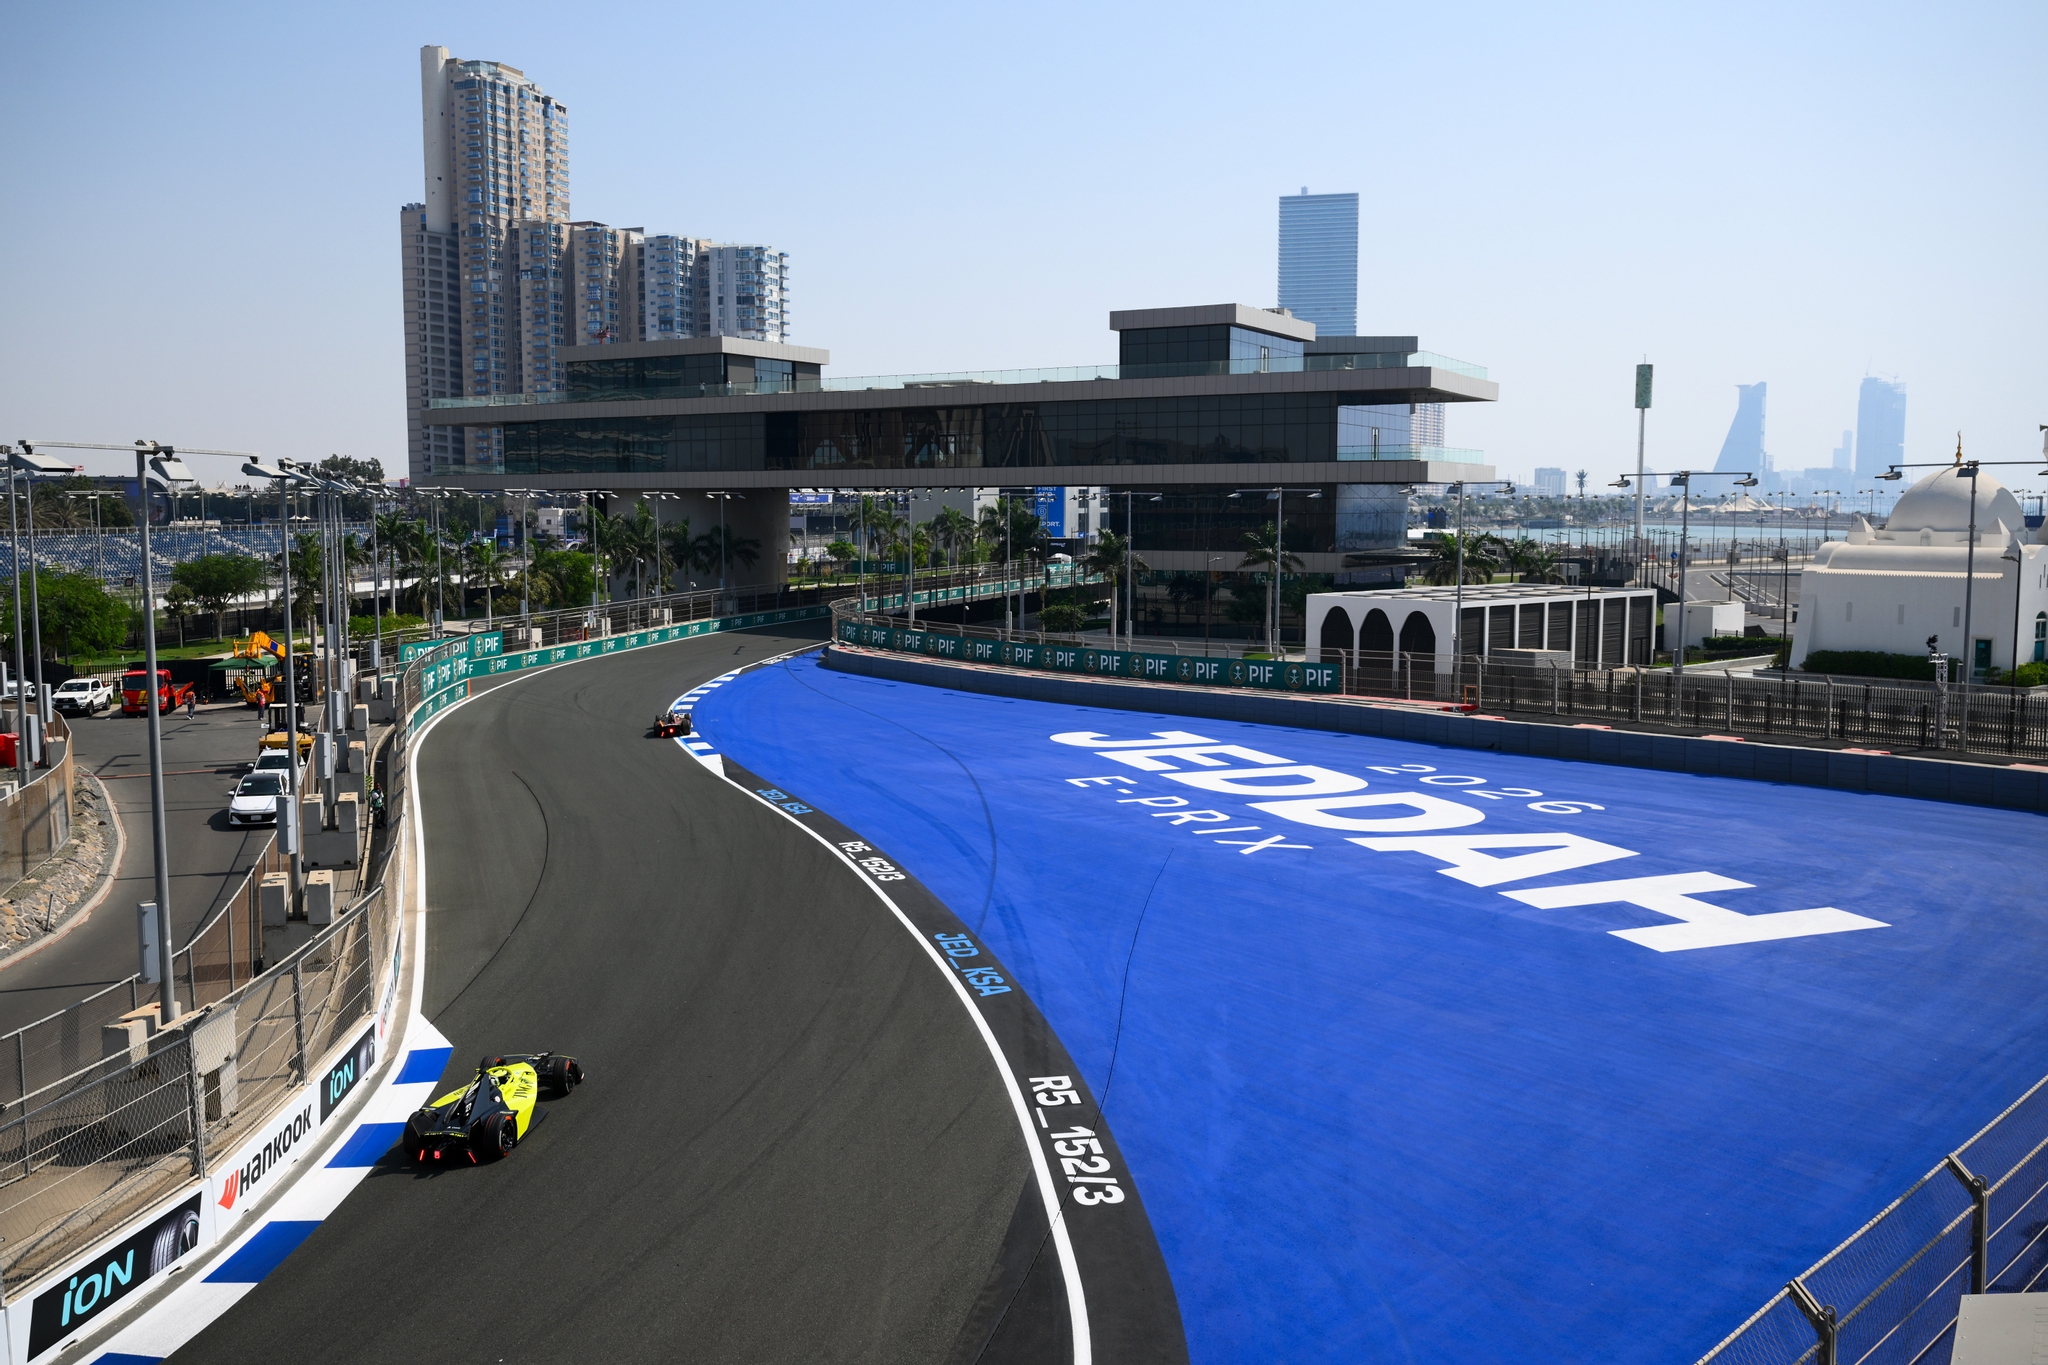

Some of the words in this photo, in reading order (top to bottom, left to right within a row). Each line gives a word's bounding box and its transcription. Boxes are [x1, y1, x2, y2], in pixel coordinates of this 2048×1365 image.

[672, 628, 680, 637] PIF
[692, 624, 700, 633] PIF
[713, 621, 721, 630] PIF
[651, 632, 660, 641] PIF
[846, 626, 856, 640] PIF
[872, 630, 887, 644] PIF
[485, 637, 499, 652] PIF
[607, 640, 616, 650] PIF
[630, 636, 638, 646] PIF
[904, 635, 921, 649] PIF
[938, 639, 955, 654] PIF
[556, 649, 566, 660] PIF
[582, 645, 592, 655] PIF
[976, 644, 993, 658] PIF
[1015, 648, 1034, 663] PIF
[497, 659, 507, 670] PIF
[528, 654, 538, 664] PIF
[1056, 652, 1076, 668] PIF
[1100, 655, 1121, 671] PIF
[458, 657, 468, 676] PIF
[1146, 659, 1168, 676] PIF
[1196, 662, 1219, 680] PIF
[442, 664, 451, 684] PIF
[1249, 665, 1274, 683] PIF
[1306, 669, 1333, 687] PIF
[1365, 763, 1607, 815] 2026
[1064, 775, 1314, 855] E-PRIX
[1049, 731, 1892, 953] JEDDAH
